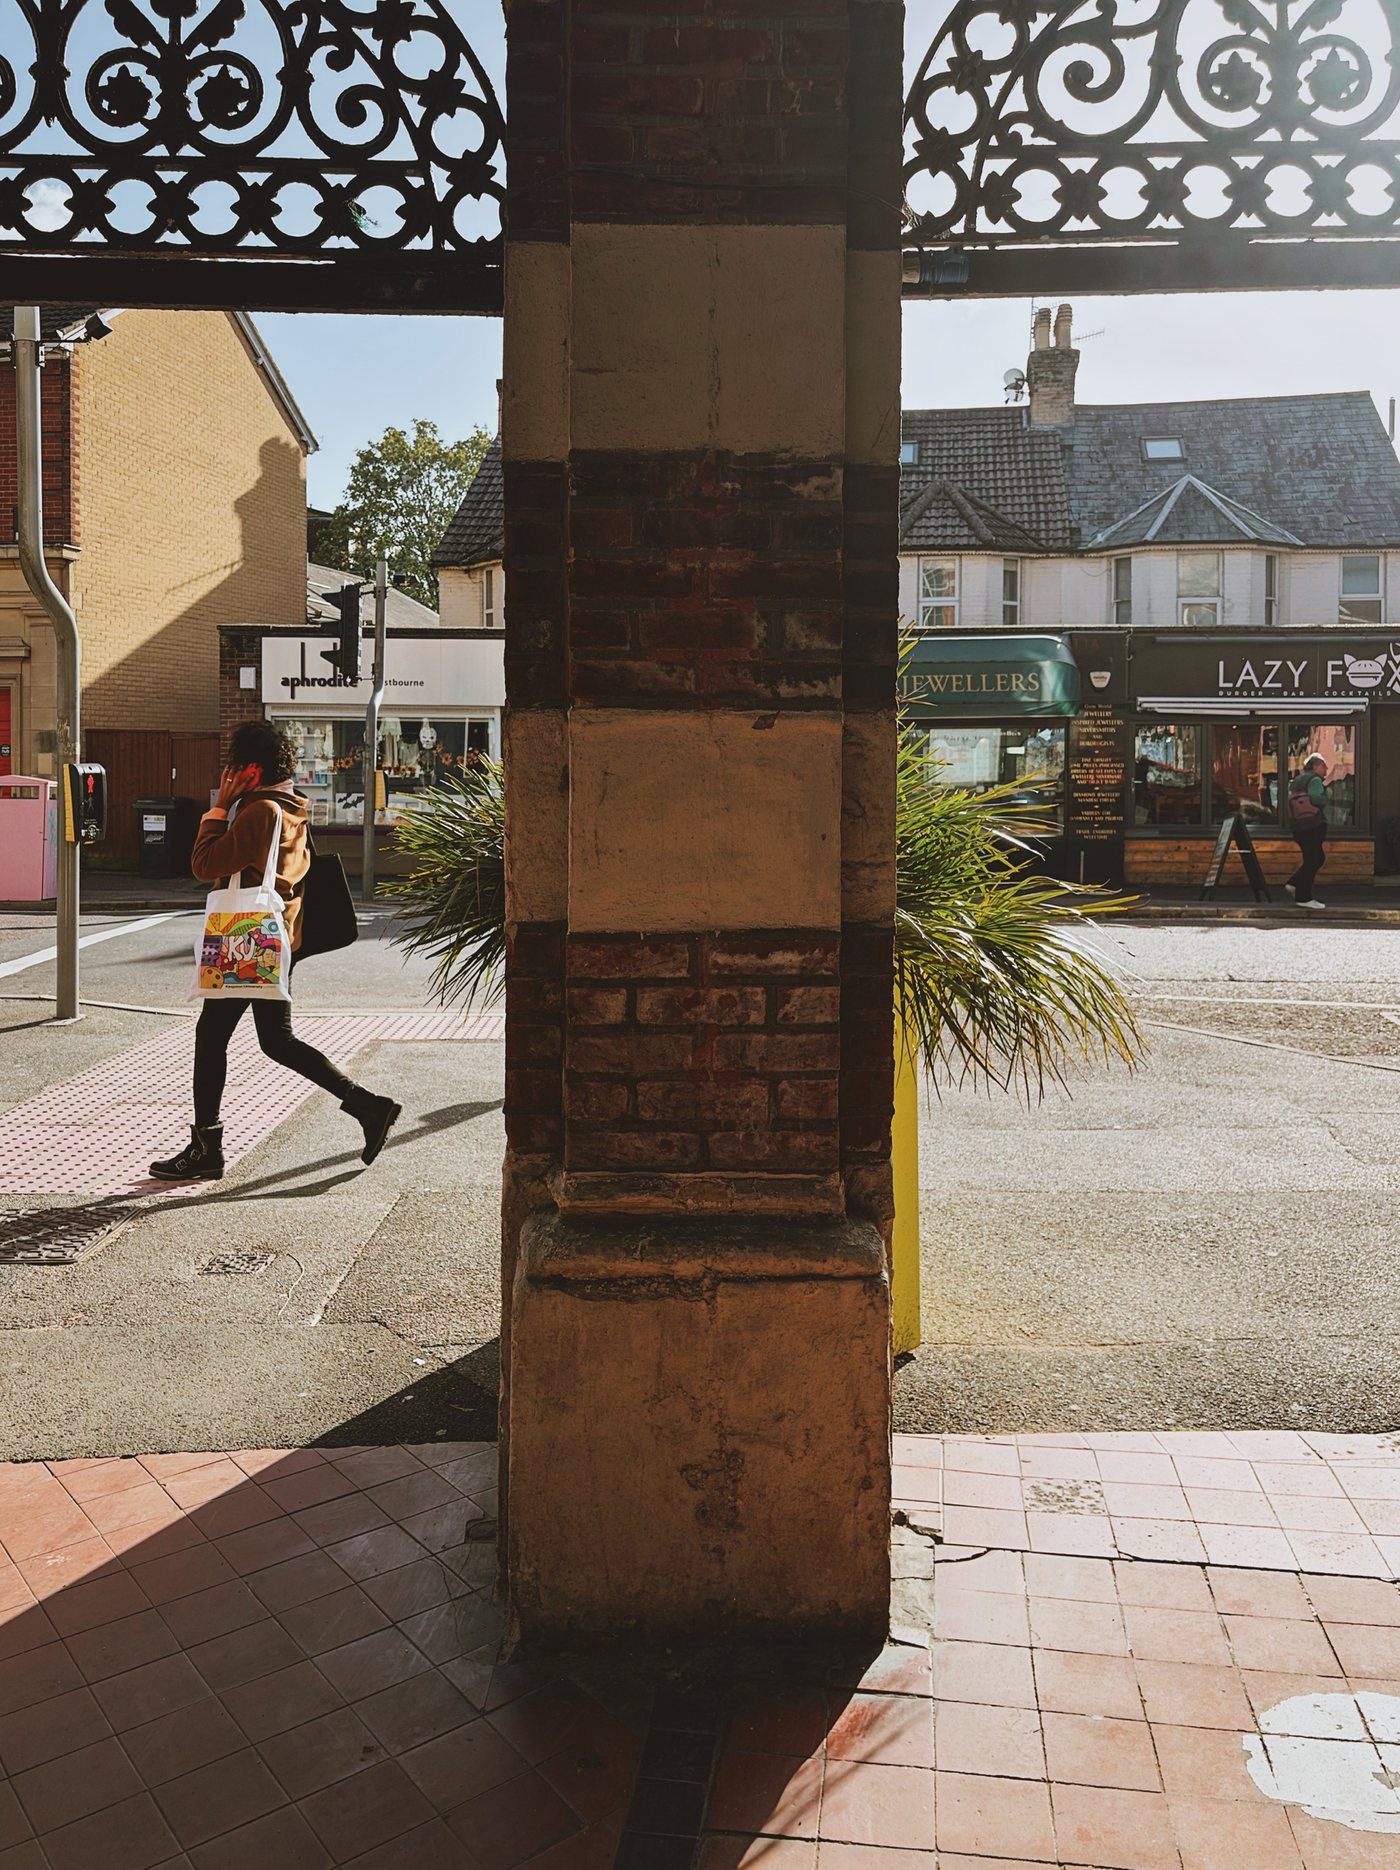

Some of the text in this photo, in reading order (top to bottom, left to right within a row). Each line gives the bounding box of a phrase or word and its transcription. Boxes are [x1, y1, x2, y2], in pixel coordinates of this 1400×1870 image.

[280, 641, 359, 700] aphrodite
[384, 678, 425, 687] stbourne
[901, 672, 1040, 694] JEWELLERS
[1218, 660, 1308, 688] LAZY
